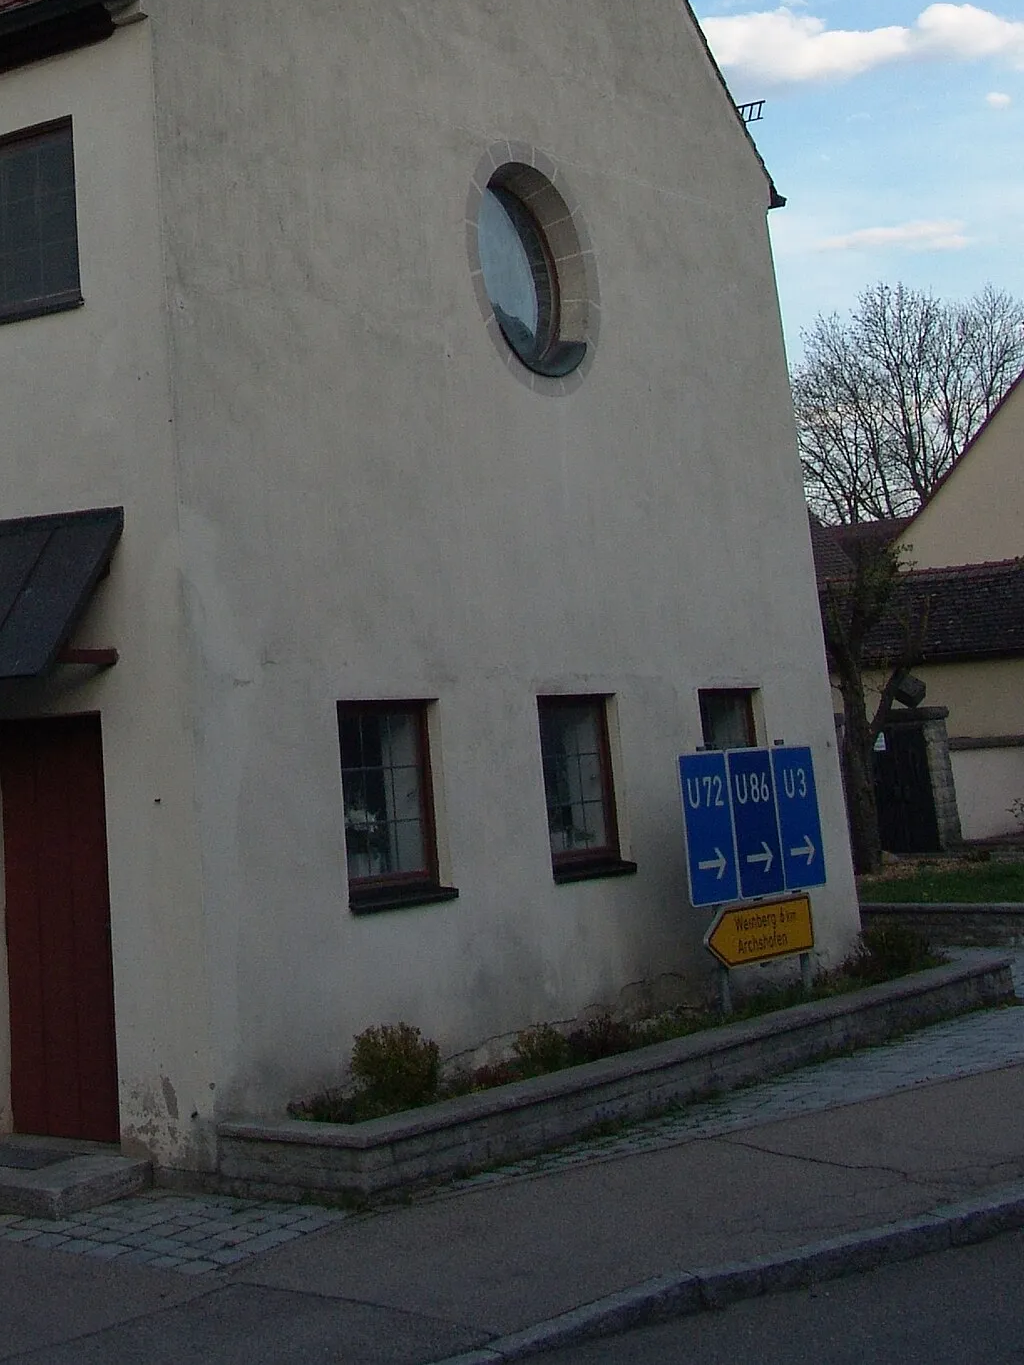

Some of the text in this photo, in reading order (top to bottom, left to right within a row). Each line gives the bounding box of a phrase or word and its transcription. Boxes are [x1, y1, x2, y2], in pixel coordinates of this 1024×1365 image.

[687, 776, 724, 808] U72
[735, 772, 769, 804] U86
[783, 768, 807, 799] U3
[738, 931, 788, 954] Archshofen
